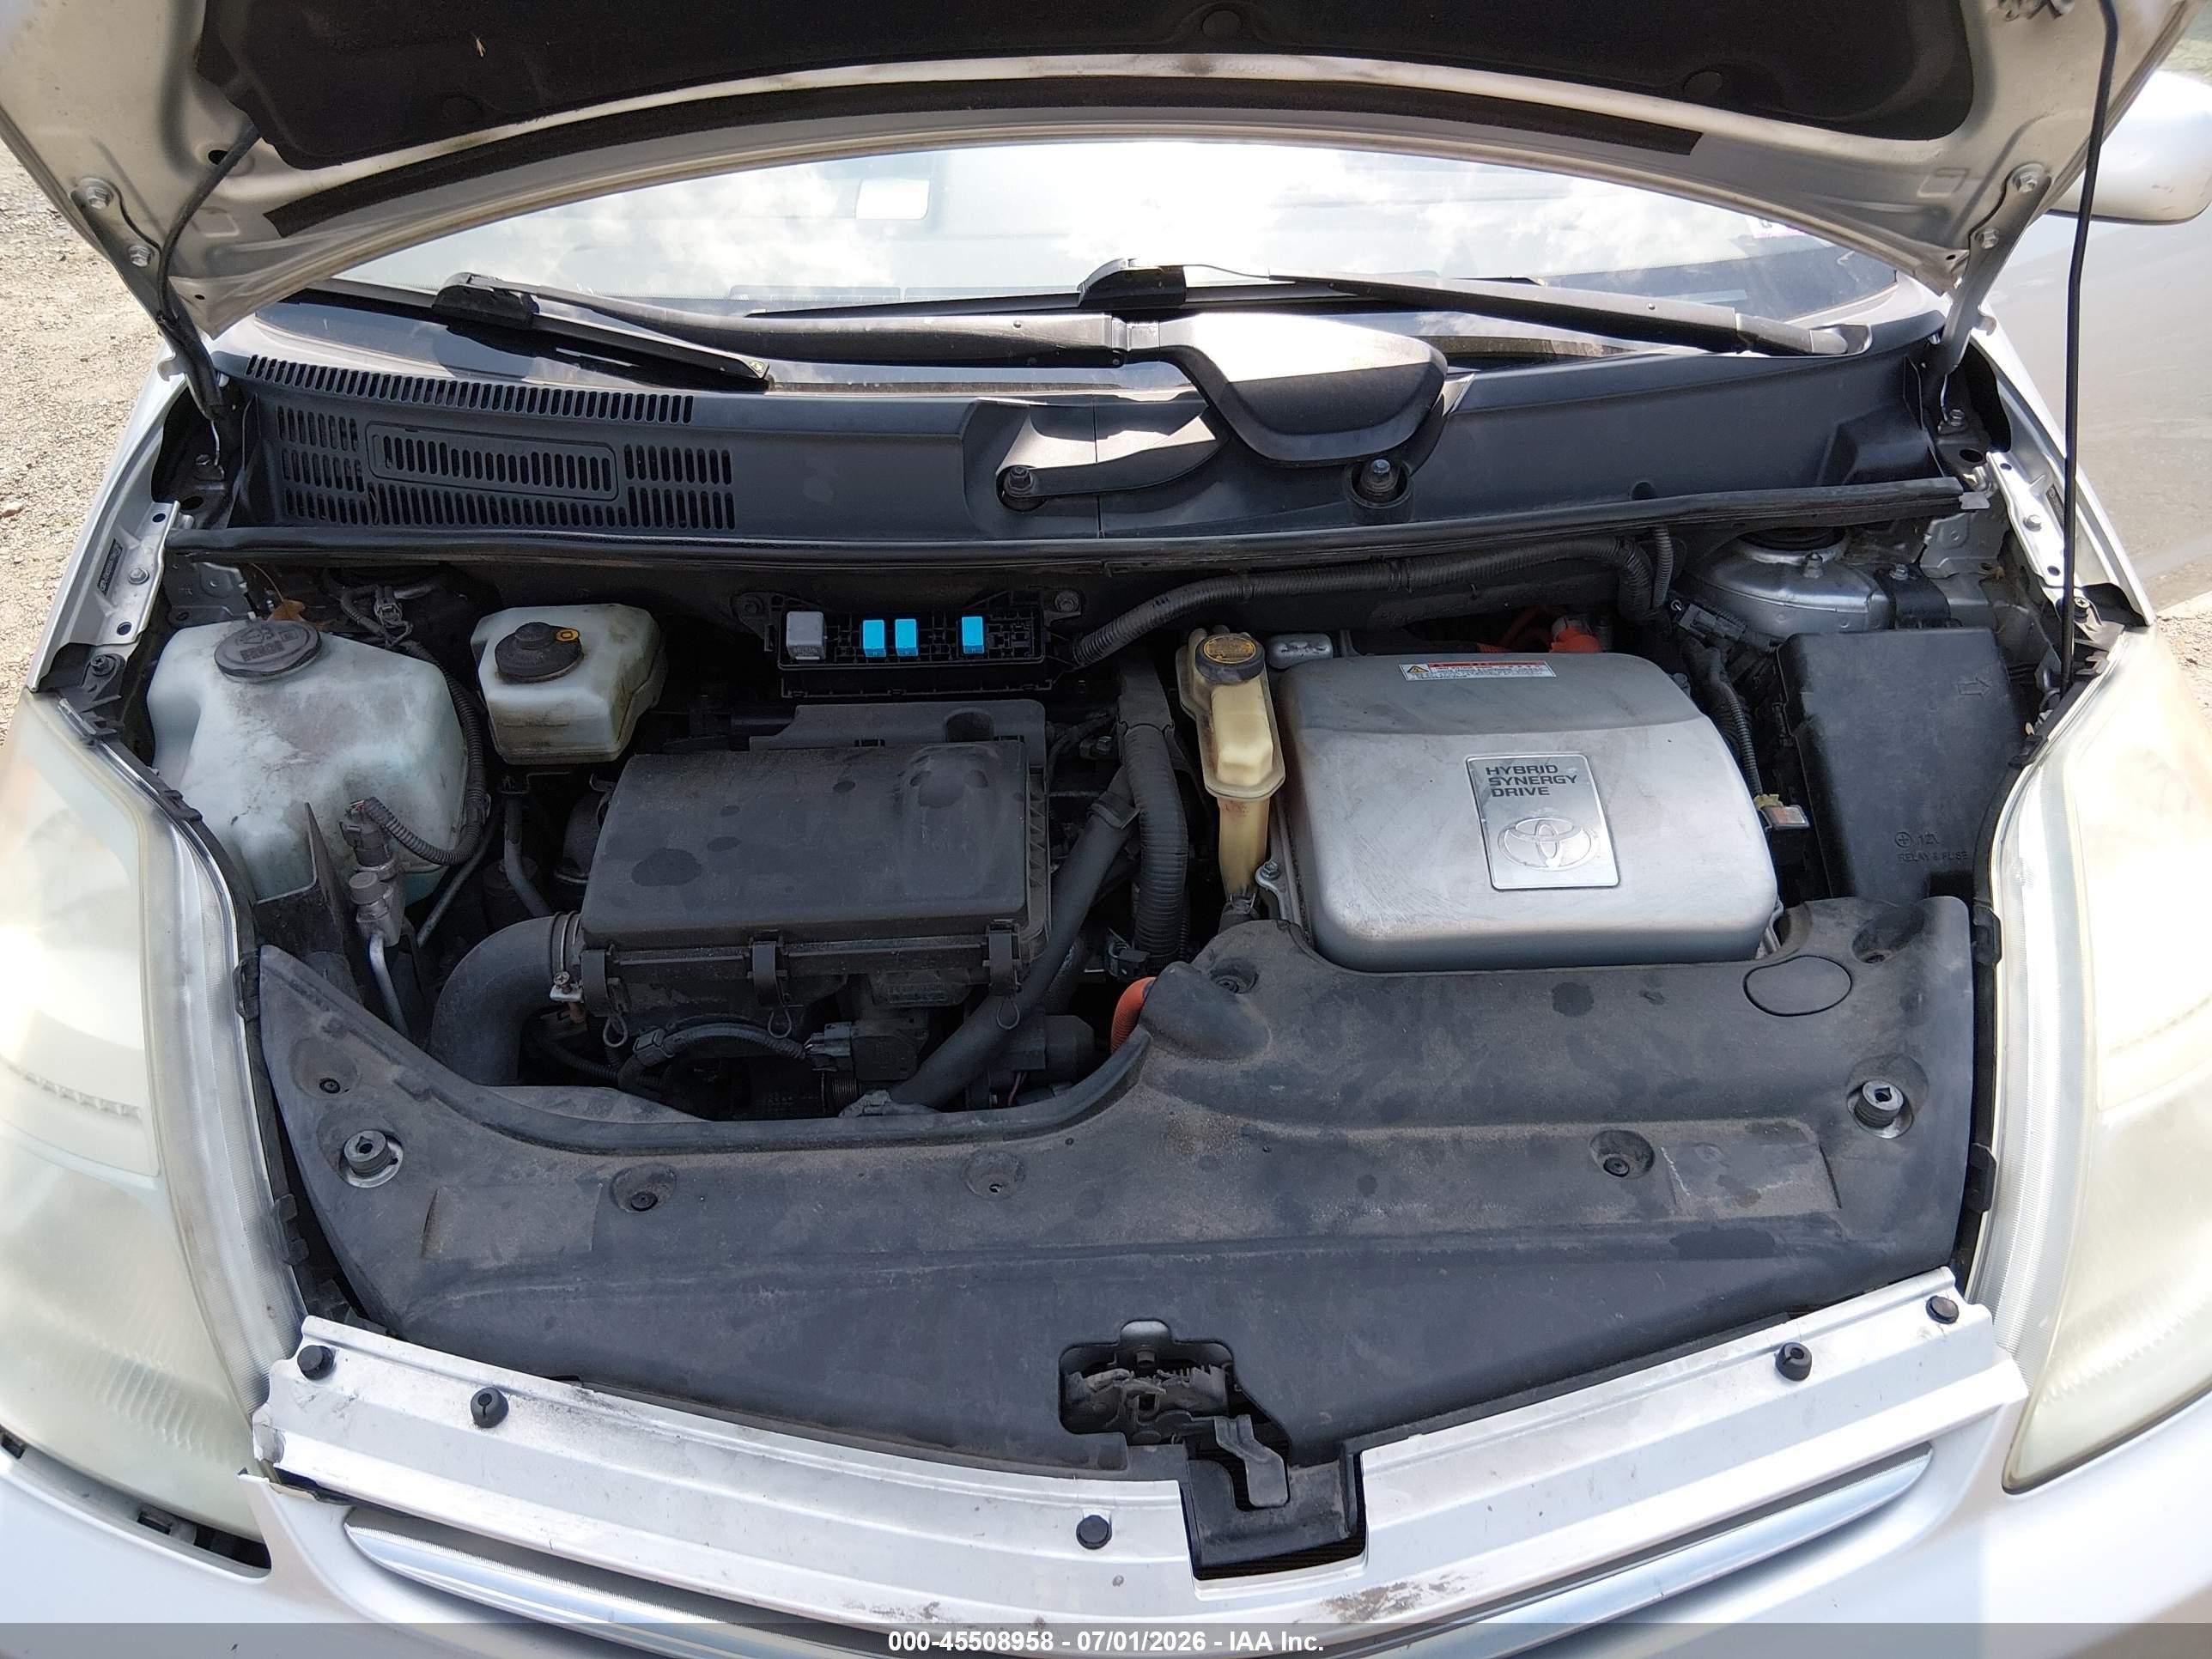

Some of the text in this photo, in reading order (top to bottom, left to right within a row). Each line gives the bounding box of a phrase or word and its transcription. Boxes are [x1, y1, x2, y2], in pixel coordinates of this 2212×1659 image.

[1486, 765, 1558, 775] HYBRID
[1488, 775, 1577, 787] SYNERGY
[1491, 787, 1550, 797] DRIVE
[1942, 850, 1968, 860] FUSE
